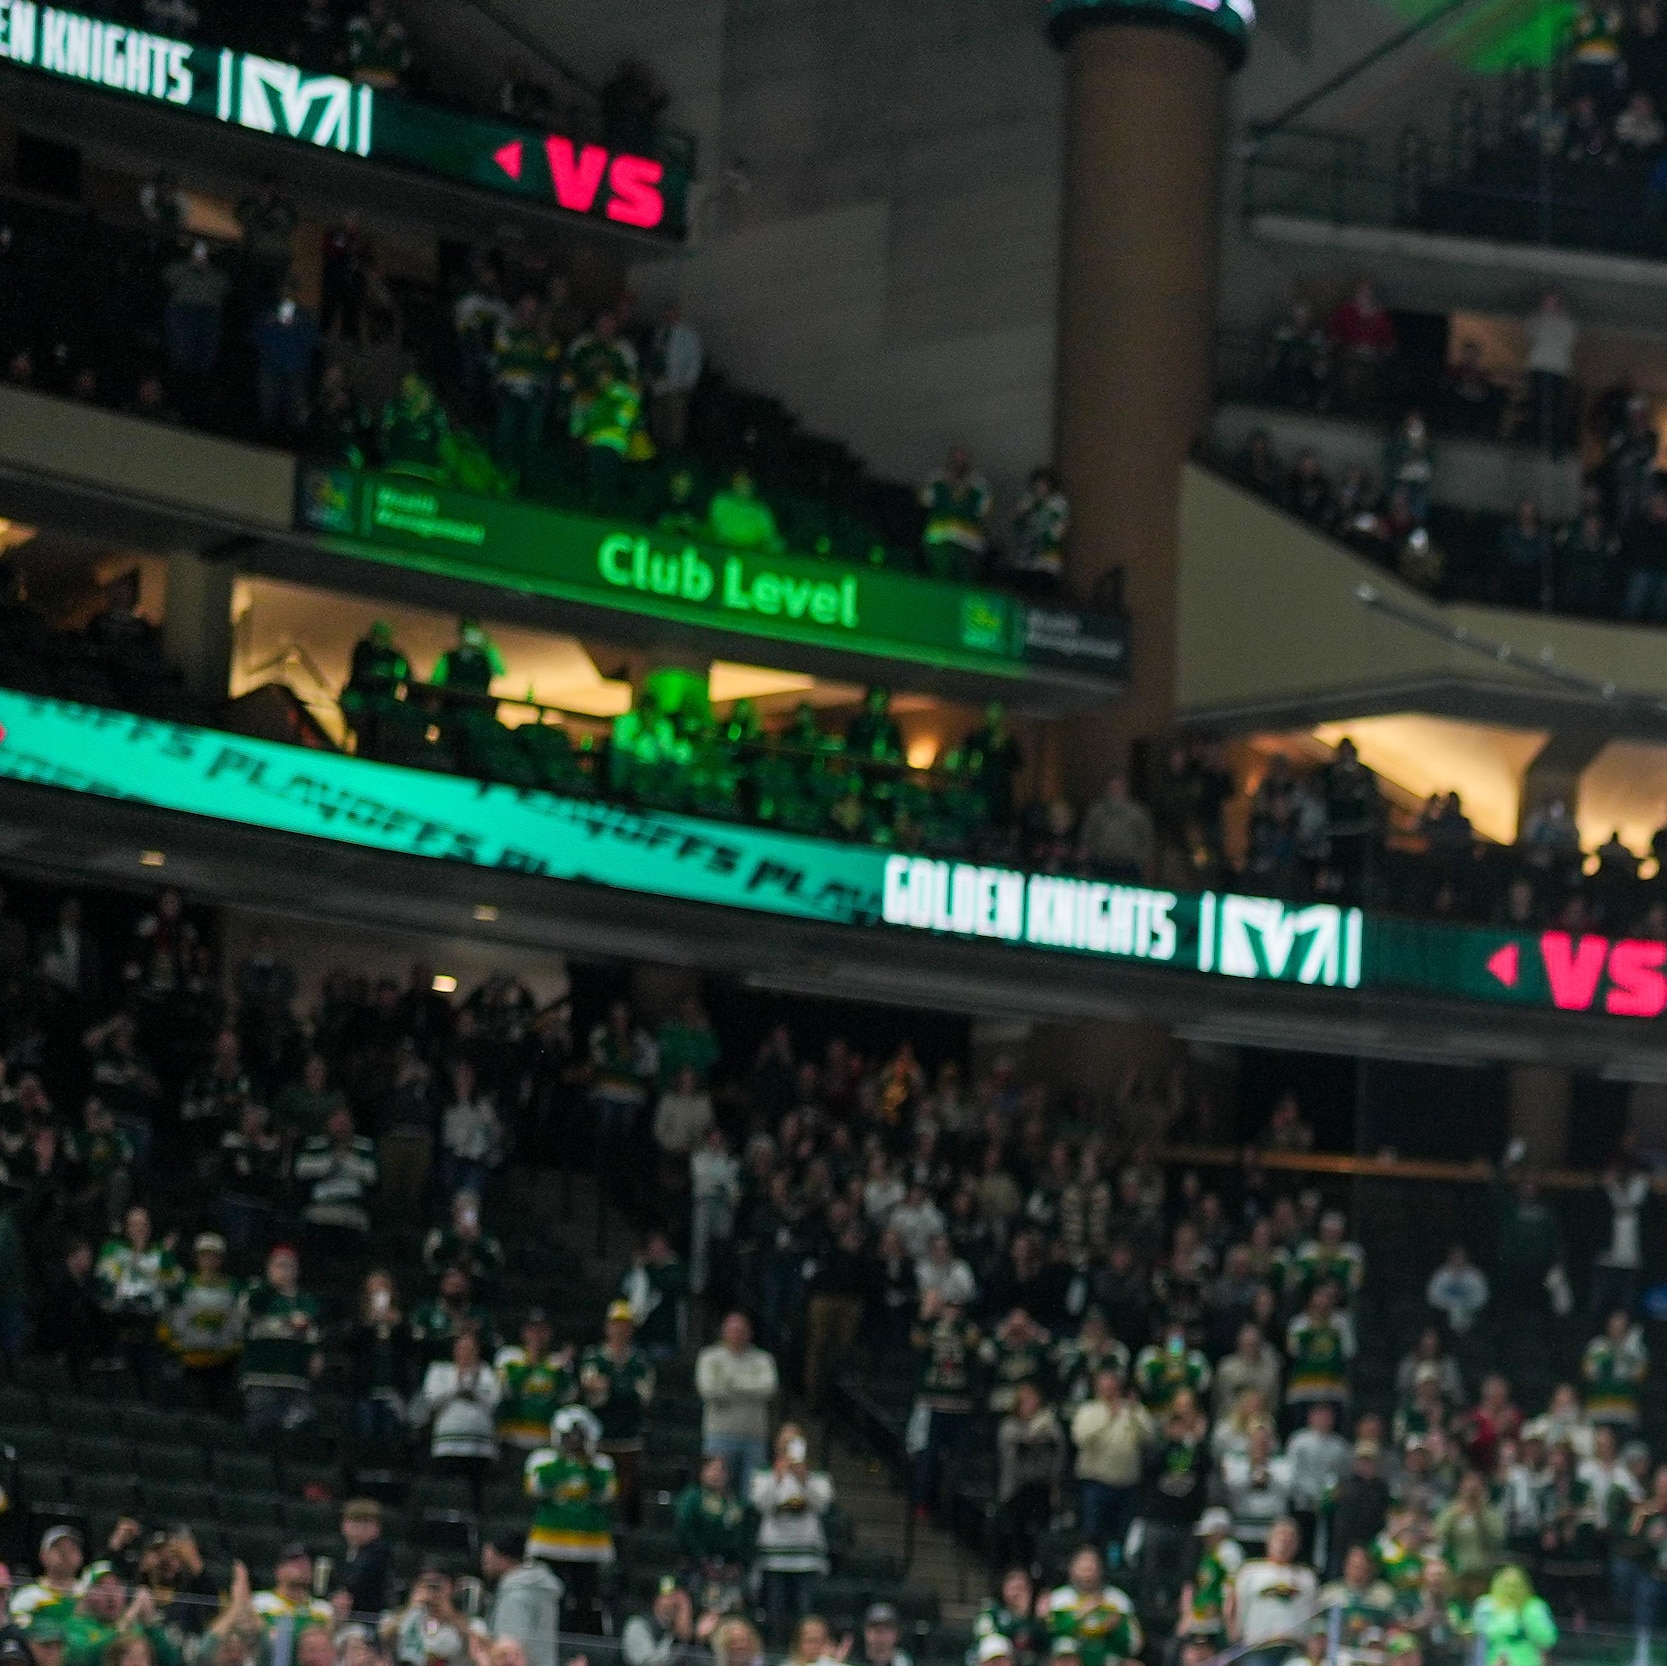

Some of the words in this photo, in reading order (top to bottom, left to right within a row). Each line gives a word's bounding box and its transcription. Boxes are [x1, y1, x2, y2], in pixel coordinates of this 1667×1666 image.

[41, 6, 193, 105] KNIGHTS
[544, 134, 664, 229] VS
[598, 533, 714, 601] Club
[722, 556, 859, 628] Level
[882, 855, 1023, 941] GOLDEN
[1027, 873, 1178, 962] KNIGHTS
